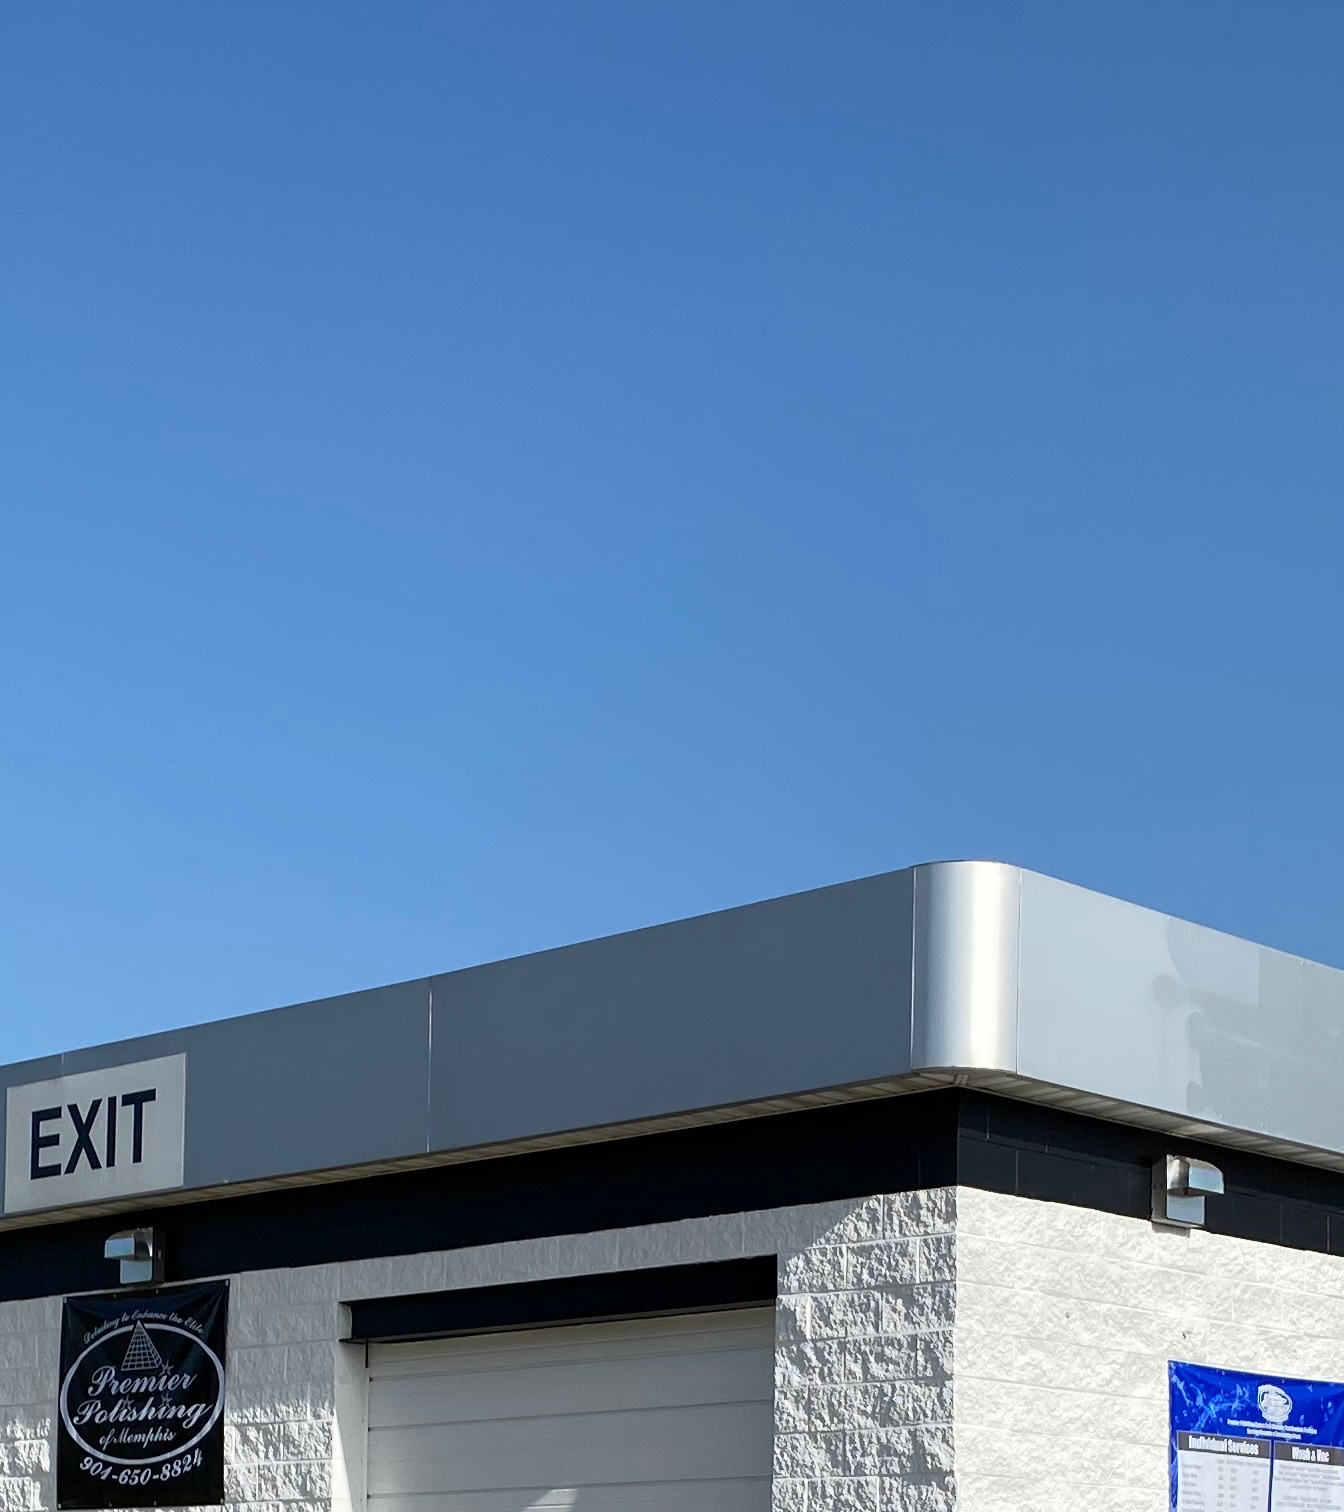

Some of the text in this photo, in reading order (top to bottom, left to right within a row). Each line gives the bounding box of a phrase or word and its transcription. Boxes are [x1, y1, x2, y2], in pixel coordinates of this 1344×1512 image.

[30, 1088, 157, 1181] EXIT
[83, 1308, 204, 1344] Detailing to Enhance the Elite
[88, 1365, 197, 1396] Premier
[73, 1396, 213, 1429] Polishing
[99, 1426, 177, 1450] of Memphis
[1188, 1434, 1259, 1456] Individual Services
[79, 1447, 204, 1486] 901-650-8824
